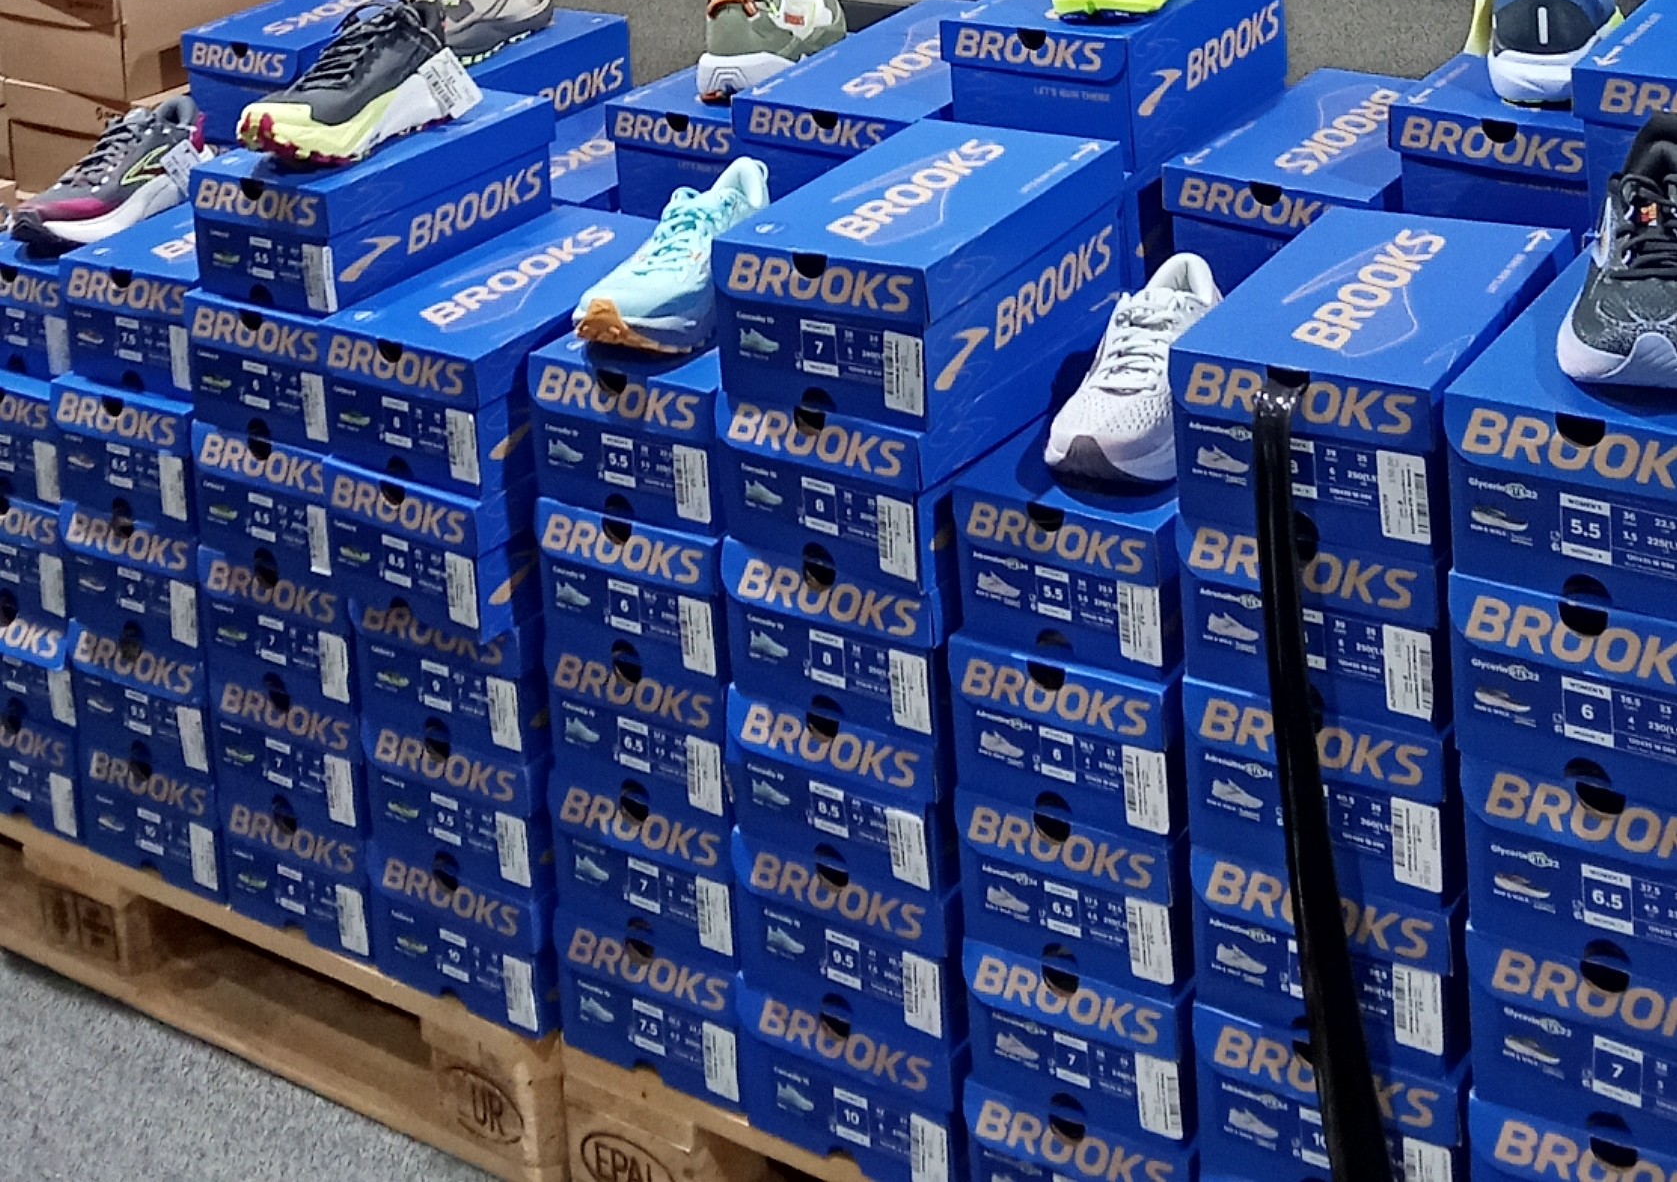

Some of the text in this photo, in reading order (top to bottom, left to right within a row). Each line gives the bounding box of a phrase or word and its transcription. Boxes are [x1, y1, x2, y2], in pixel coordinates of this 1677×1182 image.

[191, 42, 286, 78] BROOKS
[955, 26, 1105, 72] BROOKS
[1186, 0, 1280, 92] BROOKS
[614, 111, 732, 155] BROOKS
[749, 105, 886, 149] BROOKS
[1274, 89, 1400, 176] BROOKS
[1401, 115, 1586, 174] BROOKS
[195, 178, 319, 227] BROOKS
[407, 160, 544, 255] BROOKS
[826, 138, 1005, 242] BROOKS
[1178, 178, 1331, 227] BROOK
[67, 267, 185, 316] BROOKS
[419, 224, 615, 327] BROOKS
[728, 253, 914, 313] BROOKS
[994, 224, 1113, 351] BROOKS
[1292, 229, 1447, 351] BROOKS
[191, 307, 320, 363] BROOKS
[327, 334, 467, 395] BROOKS
[814, 340, 824, 355] 7
[56, 392, 177, 447] BROOKS
[536, 365, 700, 430] BROOKS
[1184, 362, 1417, 435] BROKS
[200, 432, 324, 496] BROOKS
[607, 452, 629, 469] 5.5
[728, 402, 905, 477] BROOKS
[66, 512, 189, 570] BROOKS
[330, 474, 467, 545] BROOKS
[966, 501, 1146, 574] BROOKS
[1569, 518, 1602, 539] 5.5
[541, 513, 703, 585] BROOKS
[1188, 527, 1418, 609] BROKS
[207, 560, 338, 624] BROOKS
[737, 559, 921, 636] BROOKS
[1043, 585, 1064, 601] 5.5
[73, 630, 197, 694] BROOKS
[554, 653, 714, 730] BROOKS
[220, 682, 350, 751] BROOKS
[960, 658, 1150, 736] BROOKS
[1580, 703, 1595, 721] 6
[375, 728, 517, 802] BROOKS
[623, 735, 644, 753] 6.5
[740, 704, 920, 788] BROOKS
[1199, 697, 1428, 786] BROKS
[89, 751, 207, 816] BROOKS
[229, 803, 356, 874] BROOKS
[559, 787, 721, 868] BROOKS
[967, 806, 1156, 890] BROOKS
[382, 857, 520, 937] BROOKS
[638, 878, 648, 893] 7
[750, 852, 926, 940] BROOKS
[1052, 901, 1074, 918] 6.5
[1591, 888, 1624, 911] 6.5
[567, 927, 729, 1011] BROOKS
[831, 949, 854, 969] 9.5
[639, 1019, 659, 1037] 7.5
[973, 955, 1163, 1044] BROOKS
[759, 998, 932, 1091] BROOKS
[1067, 1052, 1077, 1067] 7
[1611, 1062, 1625, 1079] 7
[843, 1107, 860, 1126] 10
